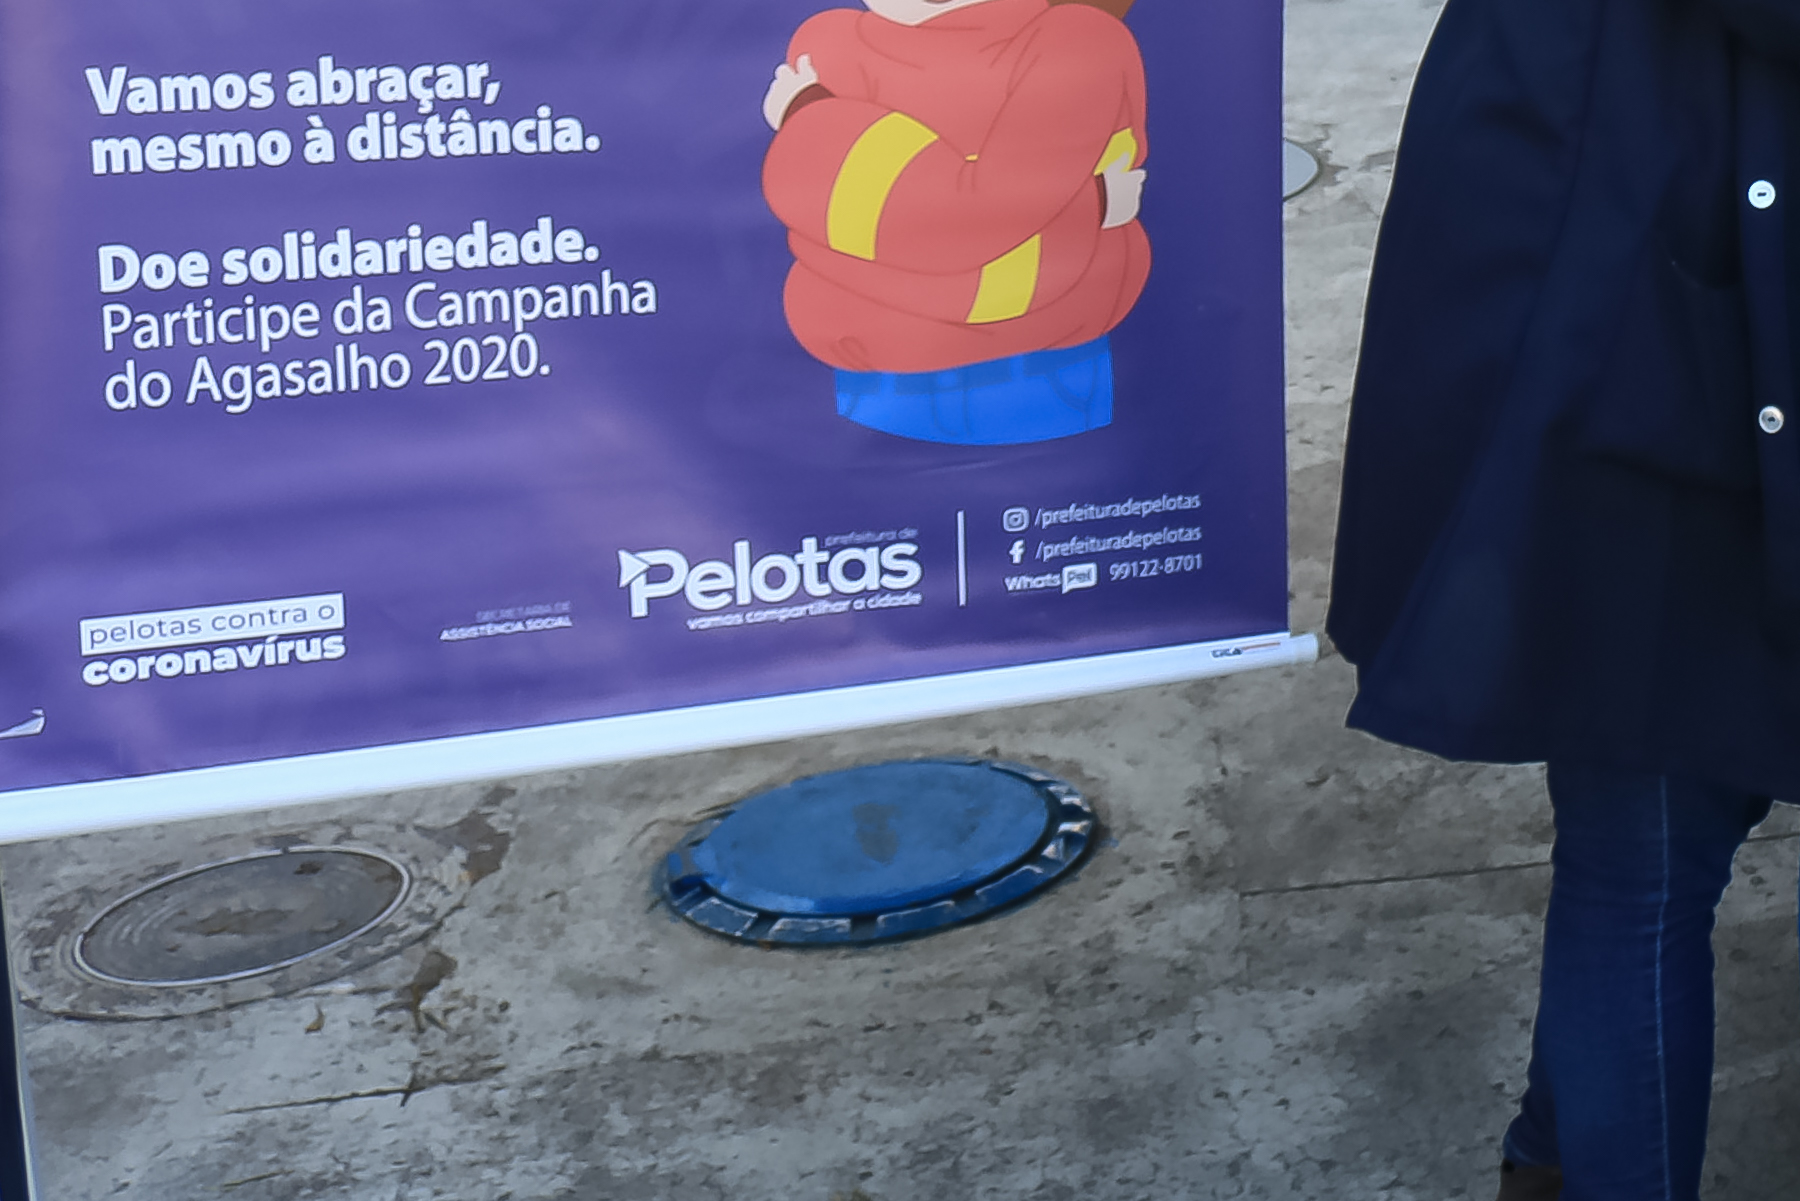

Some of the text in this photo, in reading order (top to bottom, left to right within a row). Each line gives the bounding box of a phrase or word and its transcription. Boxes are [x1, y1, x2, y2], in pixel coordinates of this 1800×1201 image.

[85, 55, 500, 116] Vamos abraçar,
[91, 105, 600, 174] mesmo à distância.
[98, 217, 599, 292] Doe solidariedade.
[102, 269, 657, 351] Participe da Campanha
[104, 332, 550, 413] do Agasalho 2020.
[619, 536, 922, 618] Pelotas
[83, 634, 346, 686] coronavírus
[90, 604, 335, 649] pelotas contra o
